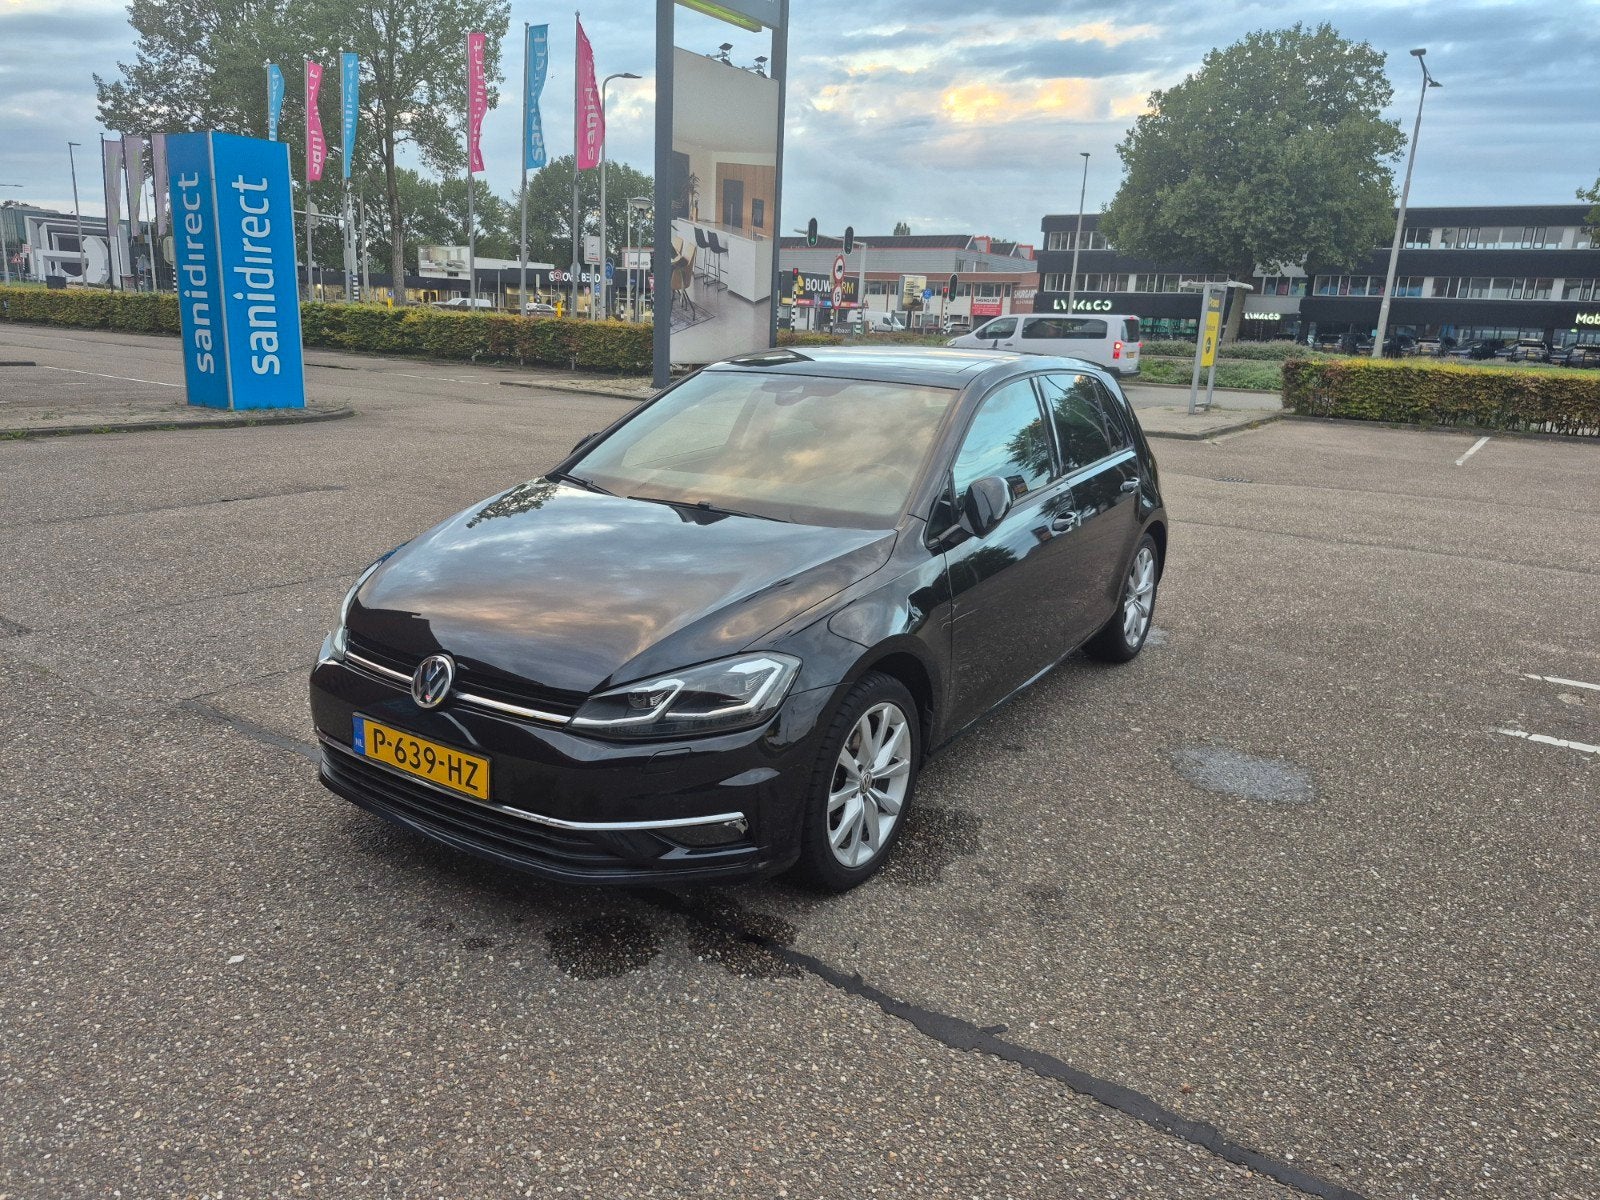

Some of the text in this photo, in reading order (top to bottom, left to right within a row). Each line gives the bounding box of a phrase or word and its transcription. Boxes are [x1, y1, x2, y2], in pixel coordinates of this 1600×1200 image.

[177, 172, 215, 375] sanidirect
[231, 175, 280, 376] sanidirect
[372, 728, 479, 792] P-639-HZ
